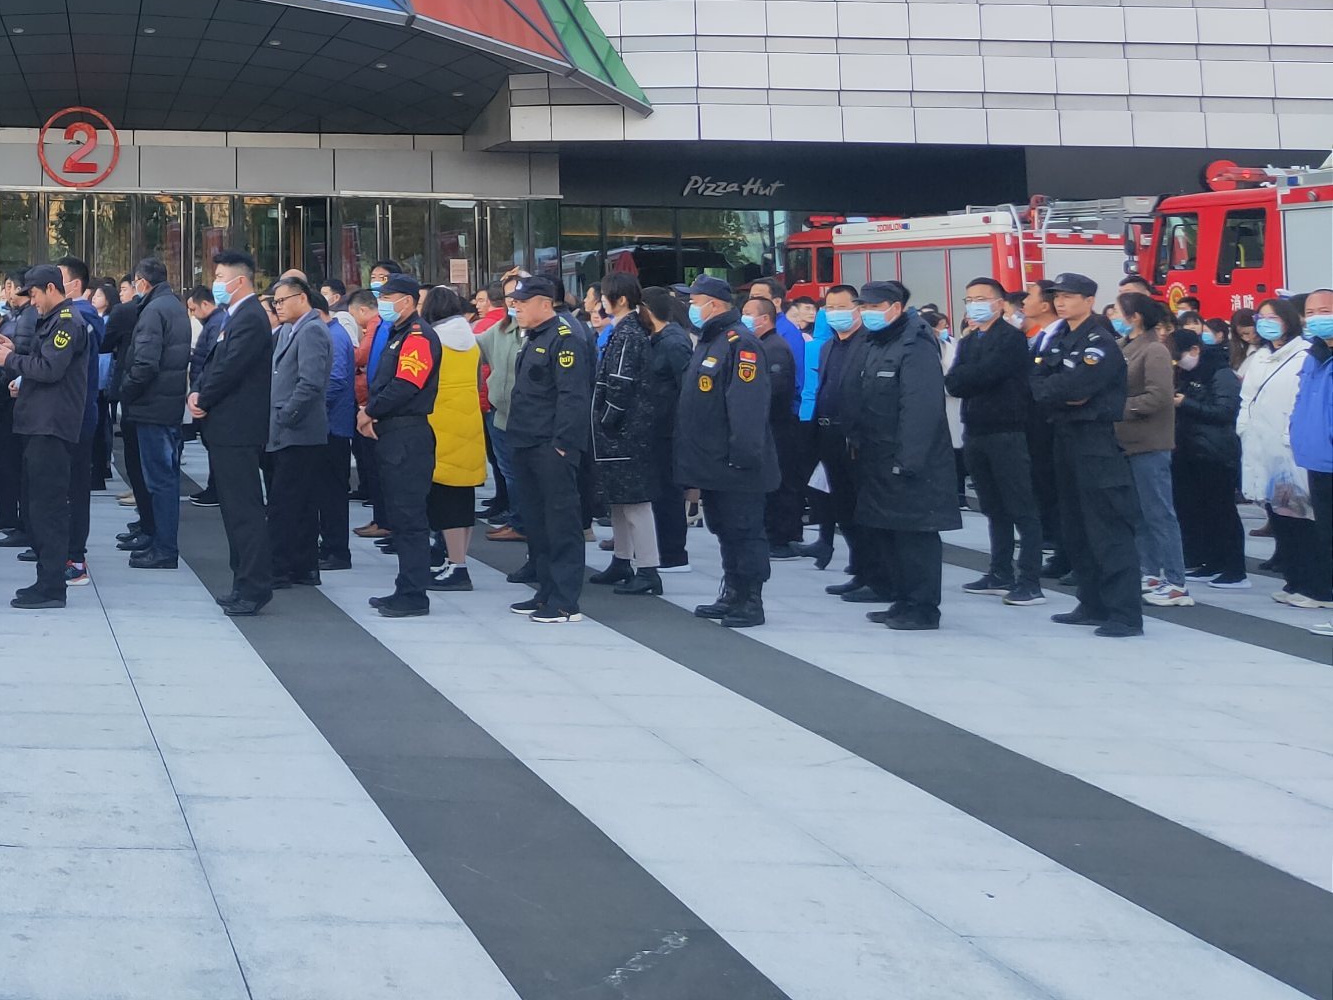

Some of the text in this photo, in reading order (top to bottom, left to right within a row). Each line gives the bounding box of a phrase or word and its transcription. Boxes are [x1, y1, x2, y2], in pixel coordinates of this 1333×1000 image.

[63, 122, 99, 174] 2
[683, 175, 786, 198] Pizza Hut
[1230, 294, 1255, 311] 消防
